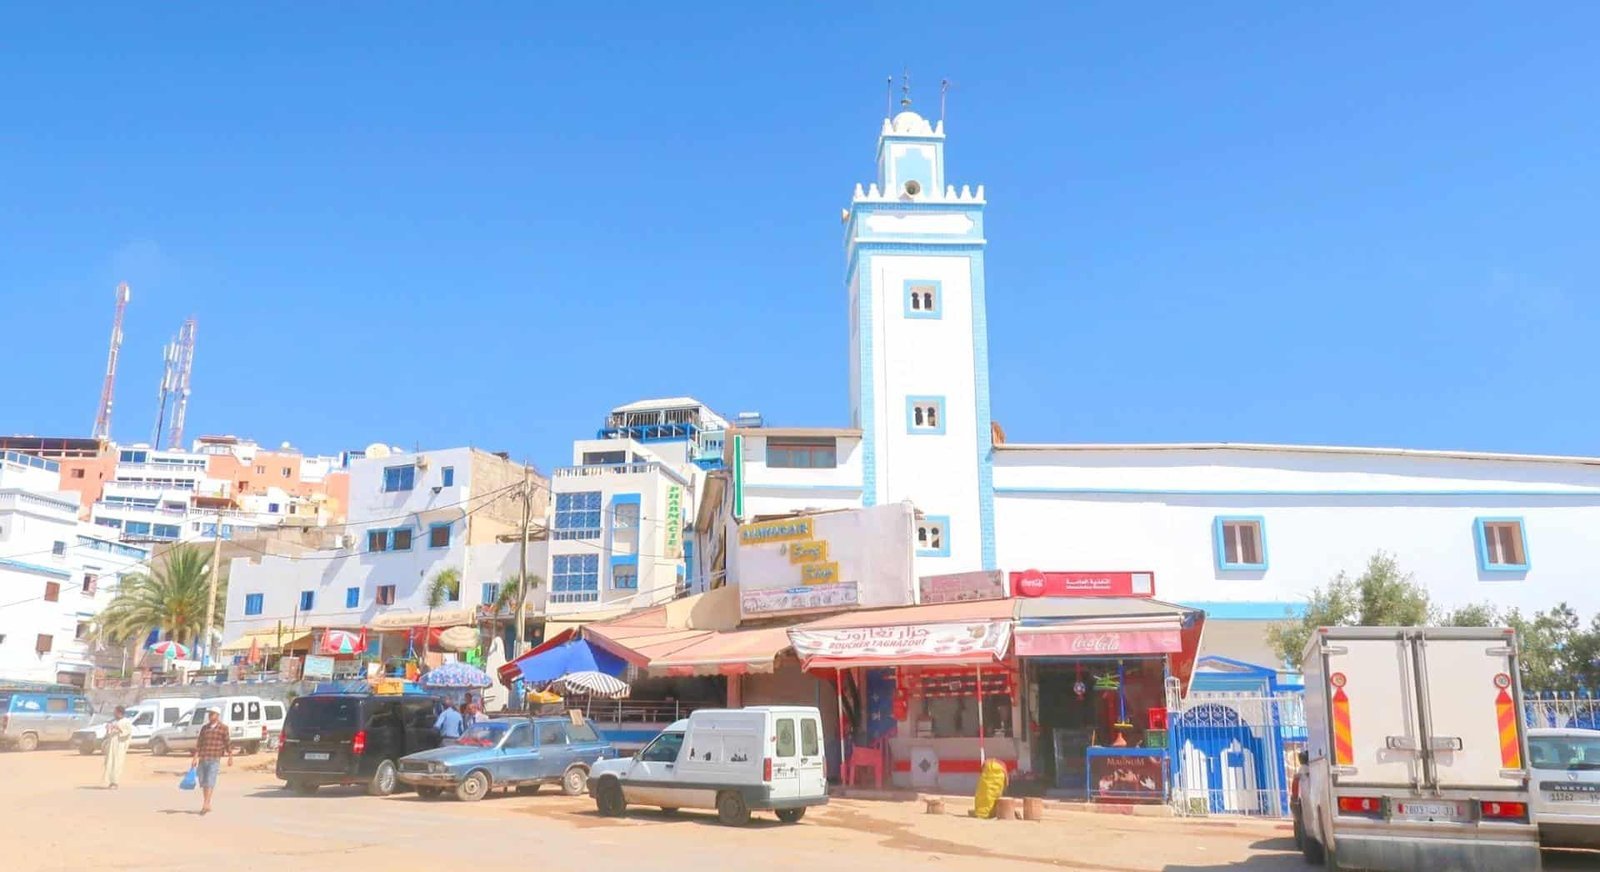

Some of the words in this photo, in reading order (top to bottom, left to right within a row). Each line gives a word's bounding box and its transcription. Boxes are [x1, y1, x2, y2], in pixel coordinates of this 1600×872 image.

[667, 486, 680, 546] PHARMACIE
[899, 626, 930, 639] جزار
[828, 641, 870, 650] BOUCHER
[872, 638, 927, 648] TAGHAZOUT
[1106, 757, 1145, 766] MAGNUM
